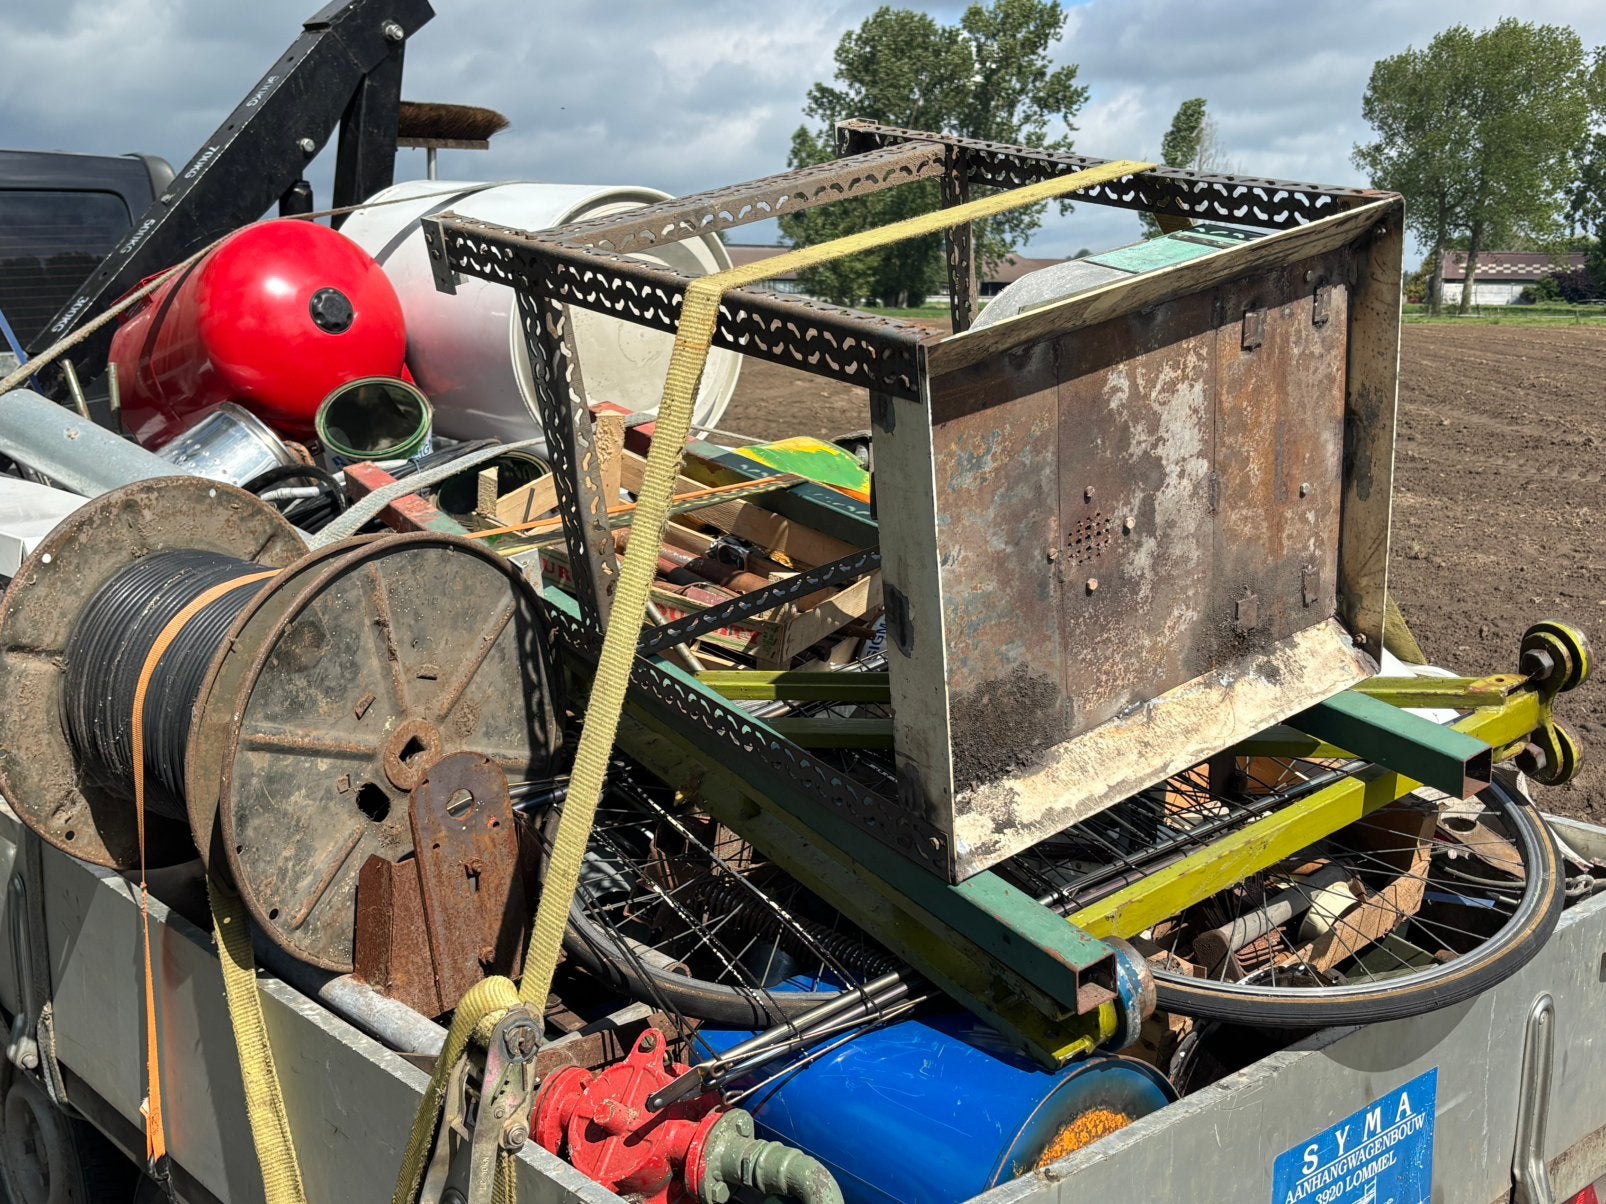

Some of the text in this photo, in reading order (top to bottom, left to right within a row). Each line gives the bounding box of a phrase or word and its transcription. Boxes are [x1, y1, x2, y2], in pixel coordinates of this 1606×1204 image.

[184, 145, 220, 178] 700KG
[120, 218, 155, 253] 500KG
[51, 296, 89, 332] 300KG
[1285, 1112, 1426, 1204] AANHANGWAGENBOUW
[1315, 1151, 1397, 1204] 3920 LOMMEL
